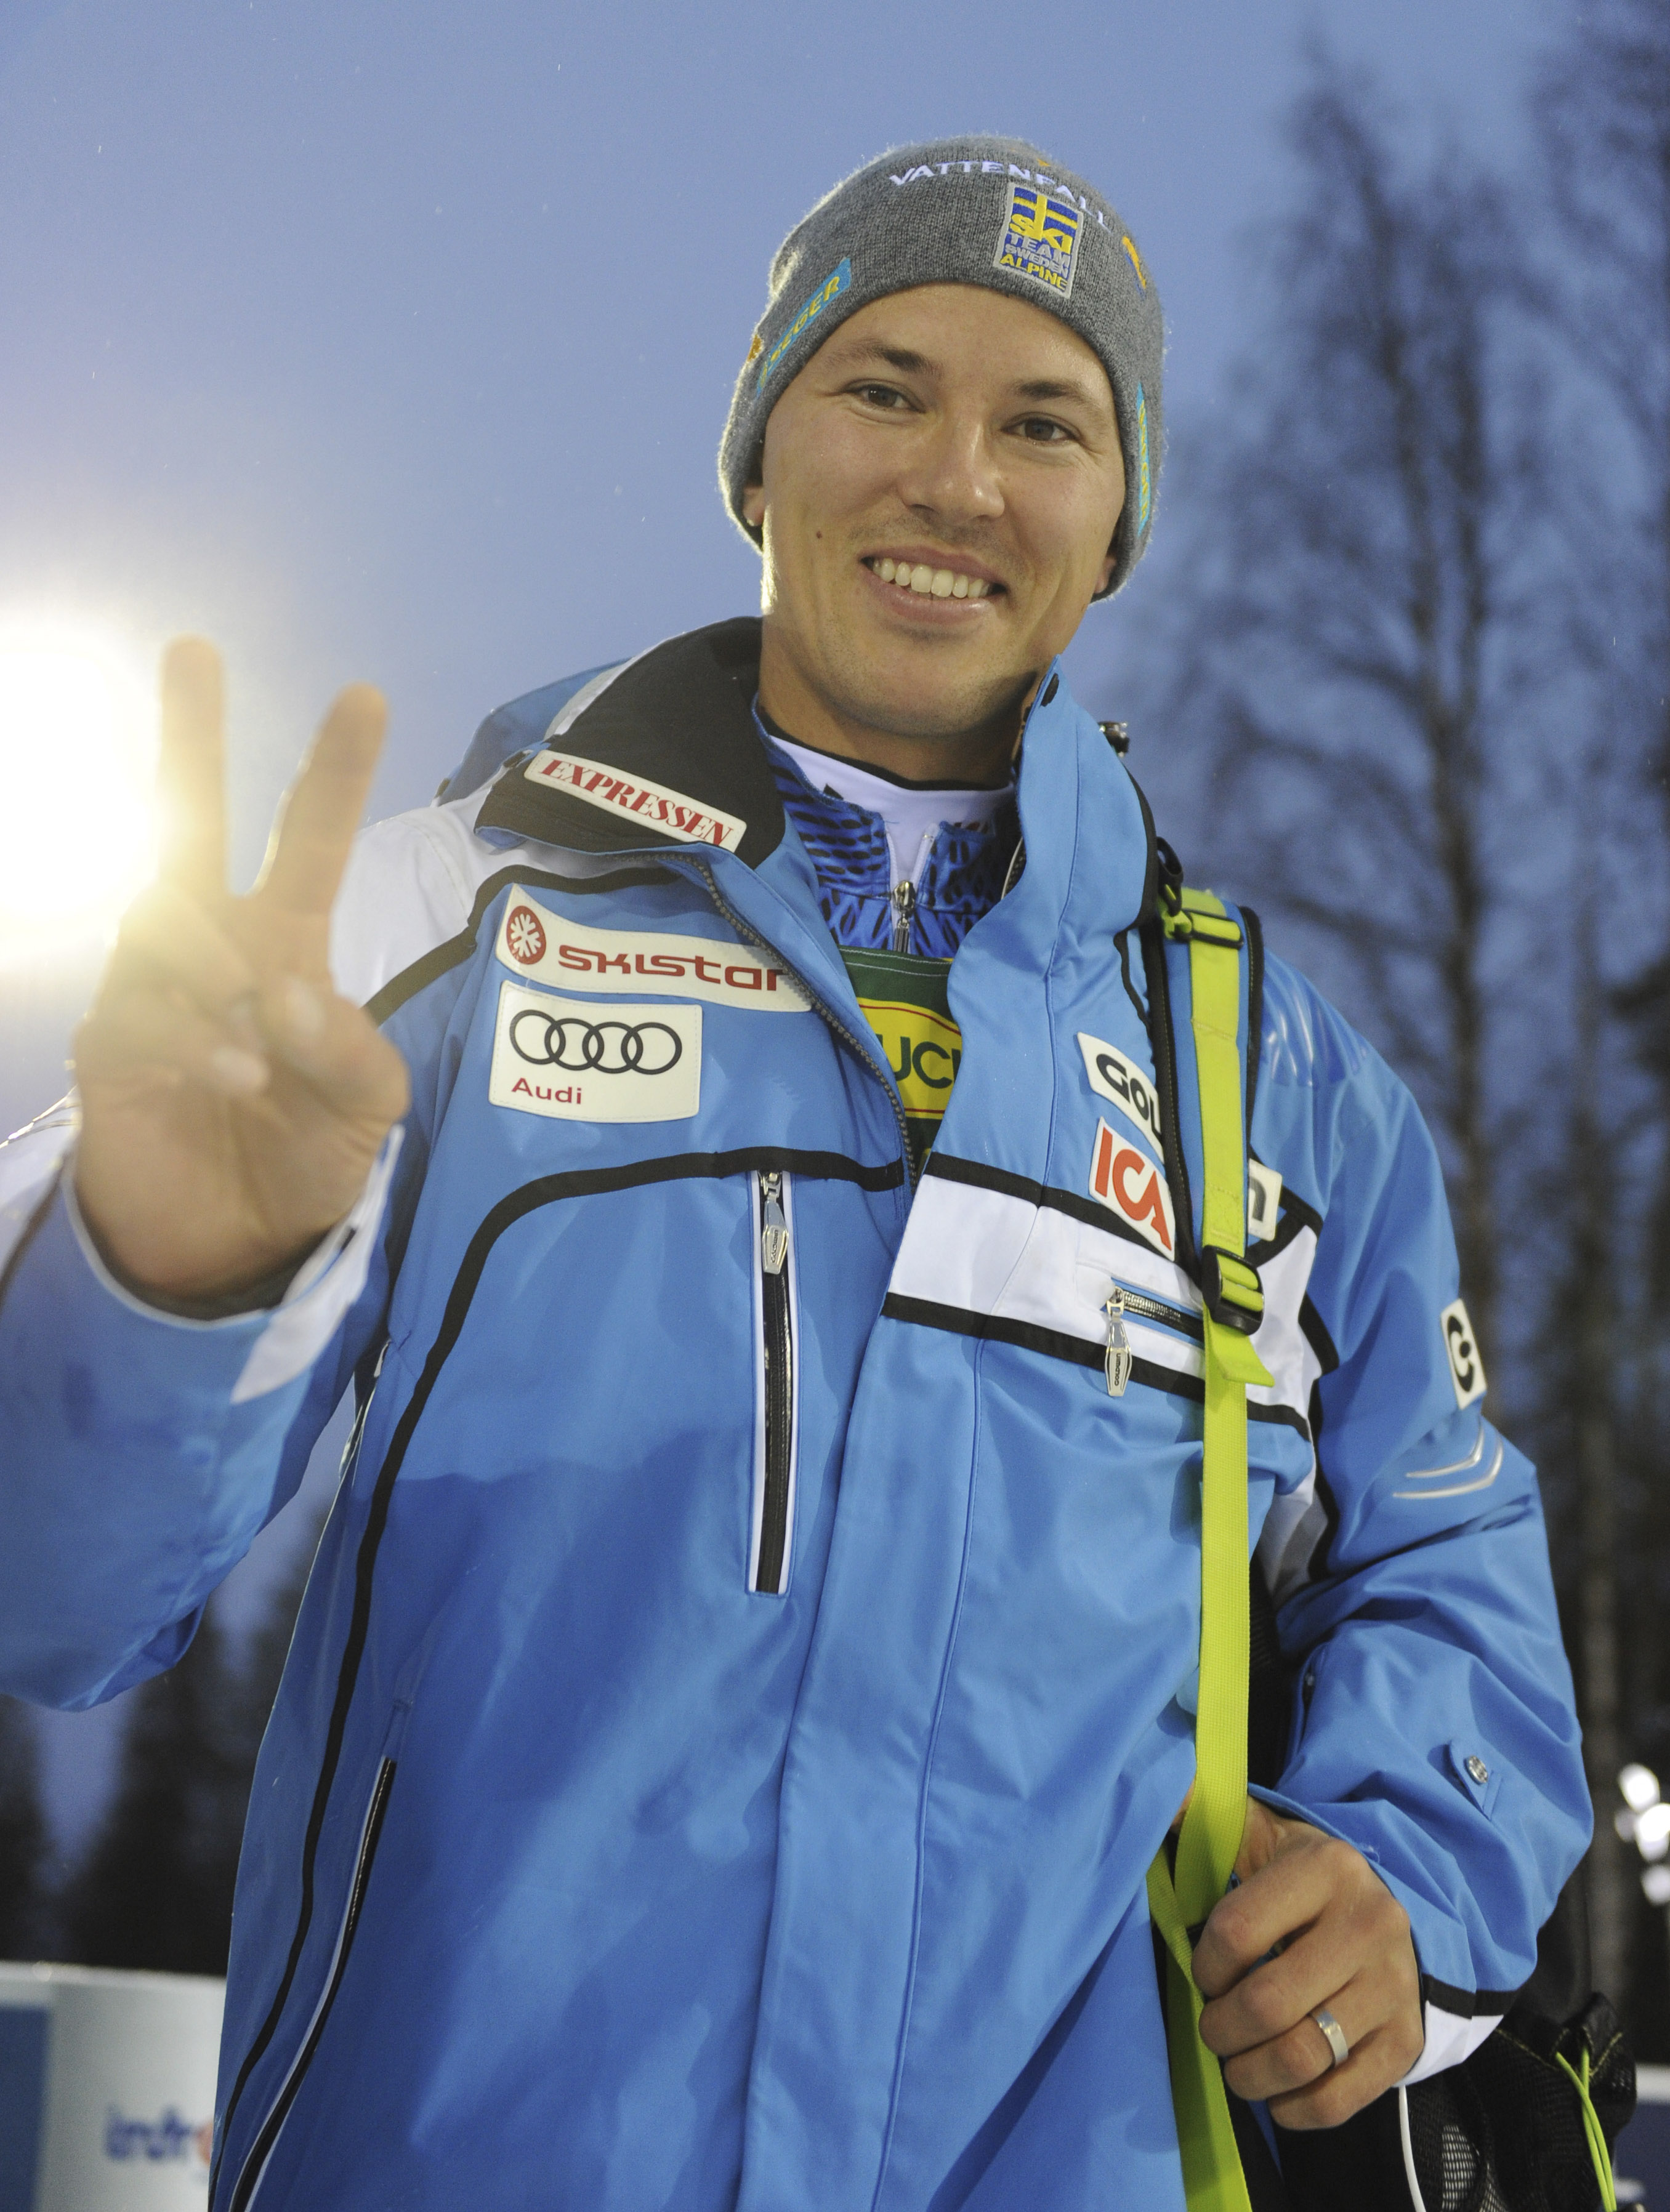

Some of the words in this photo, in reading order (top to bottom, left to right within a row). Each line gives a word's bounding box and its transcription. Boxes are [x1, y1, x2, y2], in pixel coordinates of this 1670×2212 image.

[889, 160, 1111, 233] VATTENFALL
[1009, 195, 1073, 254] SKI
[1000, 253, 1068, 291] ALPINE
[1005, 243, 1069, 279] SWEDEN
[1007, 231, 1071, 270] TEAM
[539, 758, 734, 846] EXPRESSEN
[511, 1077, 583, 1105] Audi
[1095, 1053, 1162, 1137] GOL
[1095, 1126, 1172, 1252] ICA
